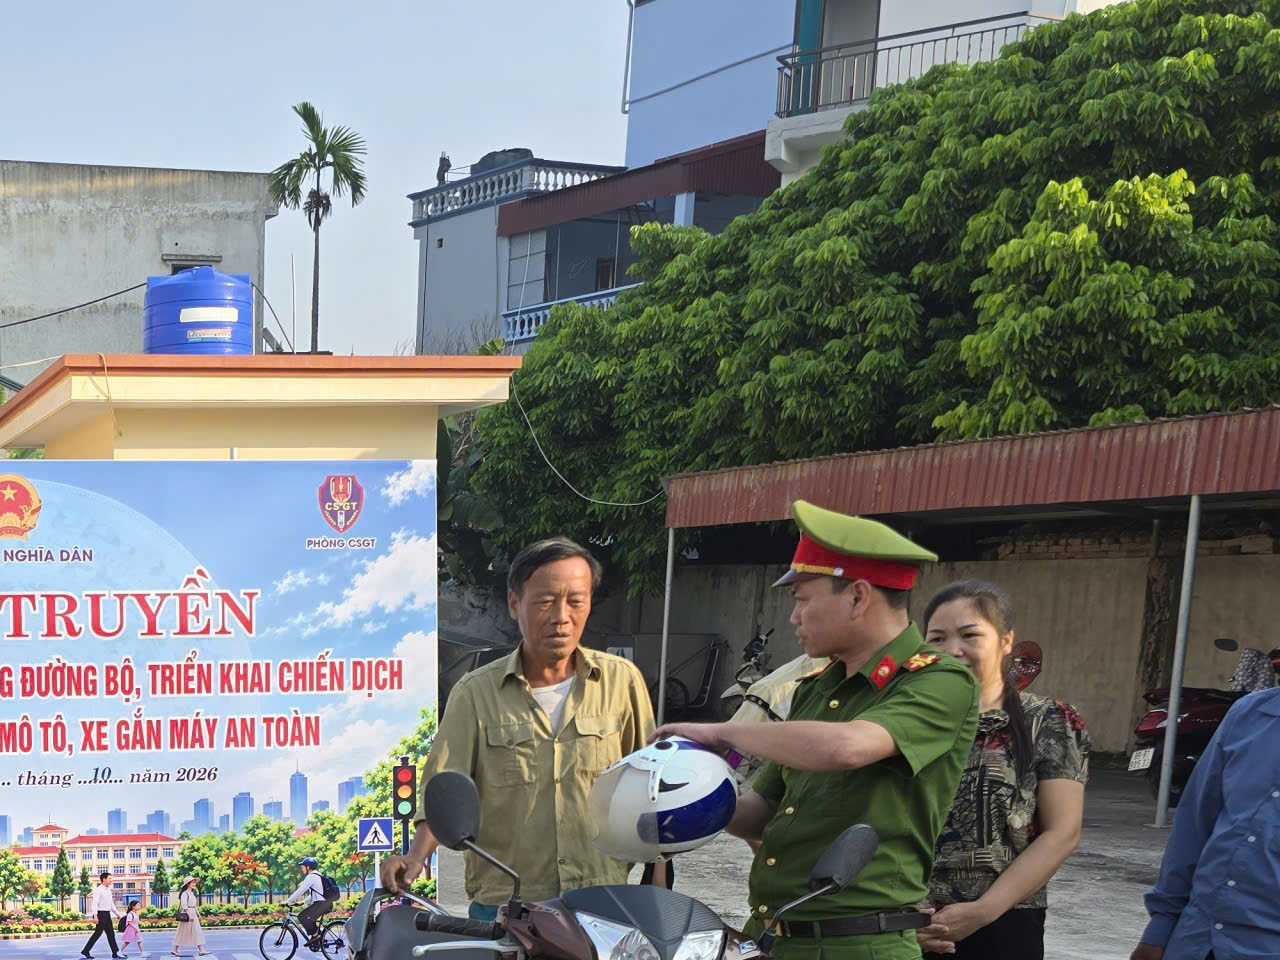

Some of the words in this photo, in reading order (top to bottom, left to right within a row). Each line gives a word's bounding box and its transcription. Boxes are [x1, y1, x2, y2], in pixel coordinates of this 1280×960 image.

[307, 536, 345, 548] PHÒNG
[348, 538, 376, 548] CSGT
[3, 546, 54, 562] NGHĨA
[59, 546, 93, 562] DÂN
[21, 658, 97, 697] ĐƯỜNG
[105, 658, 141, 702] BỘ,
[148, 650, 212, 695] TRIỂN
[220, 662, 270, 693] KHAI
[278, 650, 344, 692] CHIẾN
[352, 659, 403, 697] DỊCH
[40, 714, 73, 756] TÔ,
[81, 720, 108, 751] XE
[116, 708, 161, 750] GẮN
[170, 711, 218, 749] MÁY
[225, 717, 255, 748] AN
[262, 709, 320, 747] TOÀN
[17, 770, 73, 787] tháng
[129, 769, 170, 783] năm
[176, 766, 218, 782] 2026
